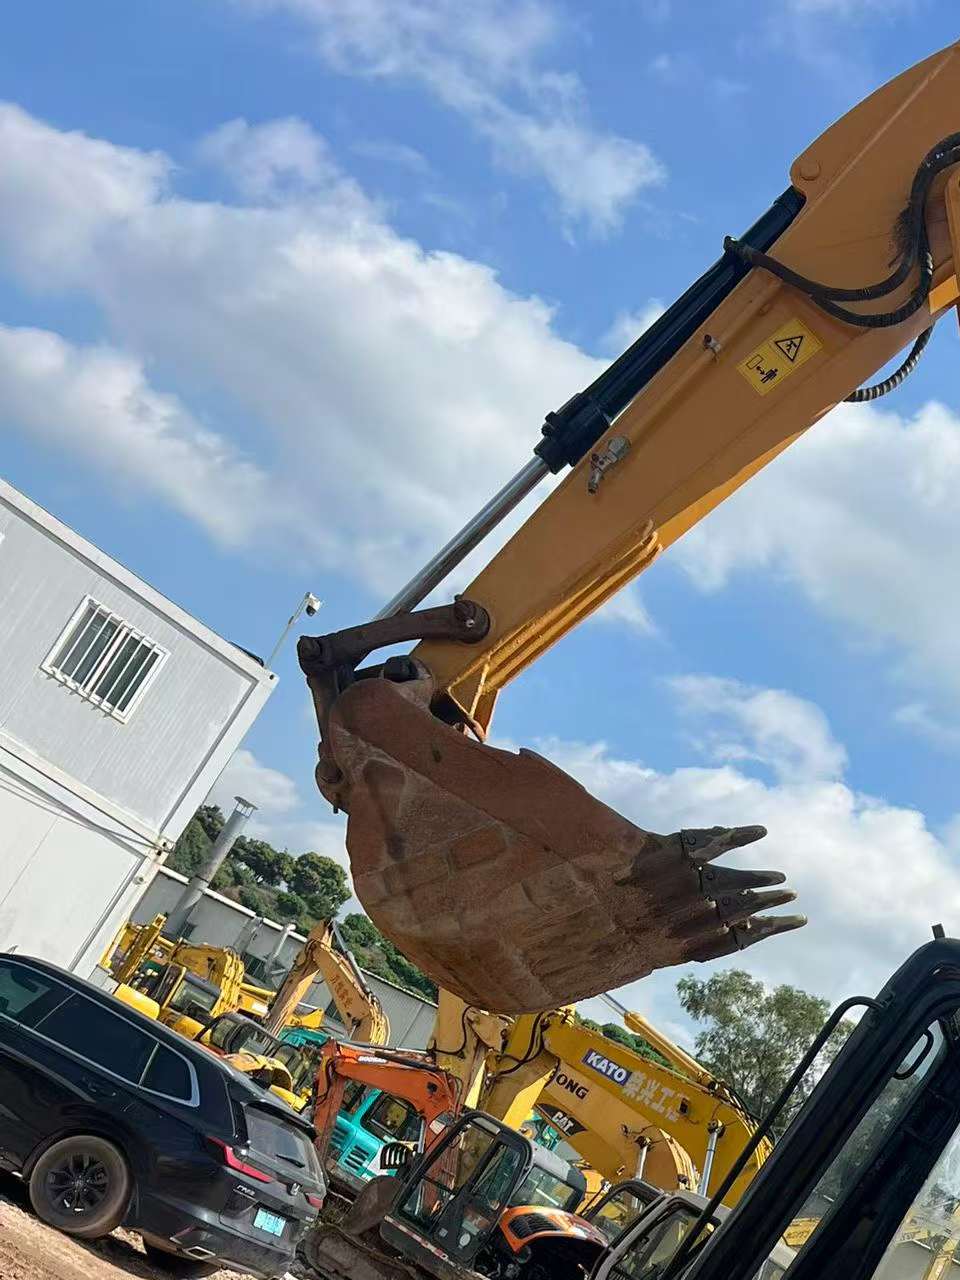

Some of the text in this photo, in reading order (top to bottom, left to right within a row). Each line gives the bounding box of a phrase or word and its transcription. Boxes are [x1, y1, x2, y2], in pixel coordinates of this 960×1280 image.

[586, 1051, 627, 1083] KATO
[551, 1070, 590, 1100] ONG
[551, 1111, 575, 1132] CAT
